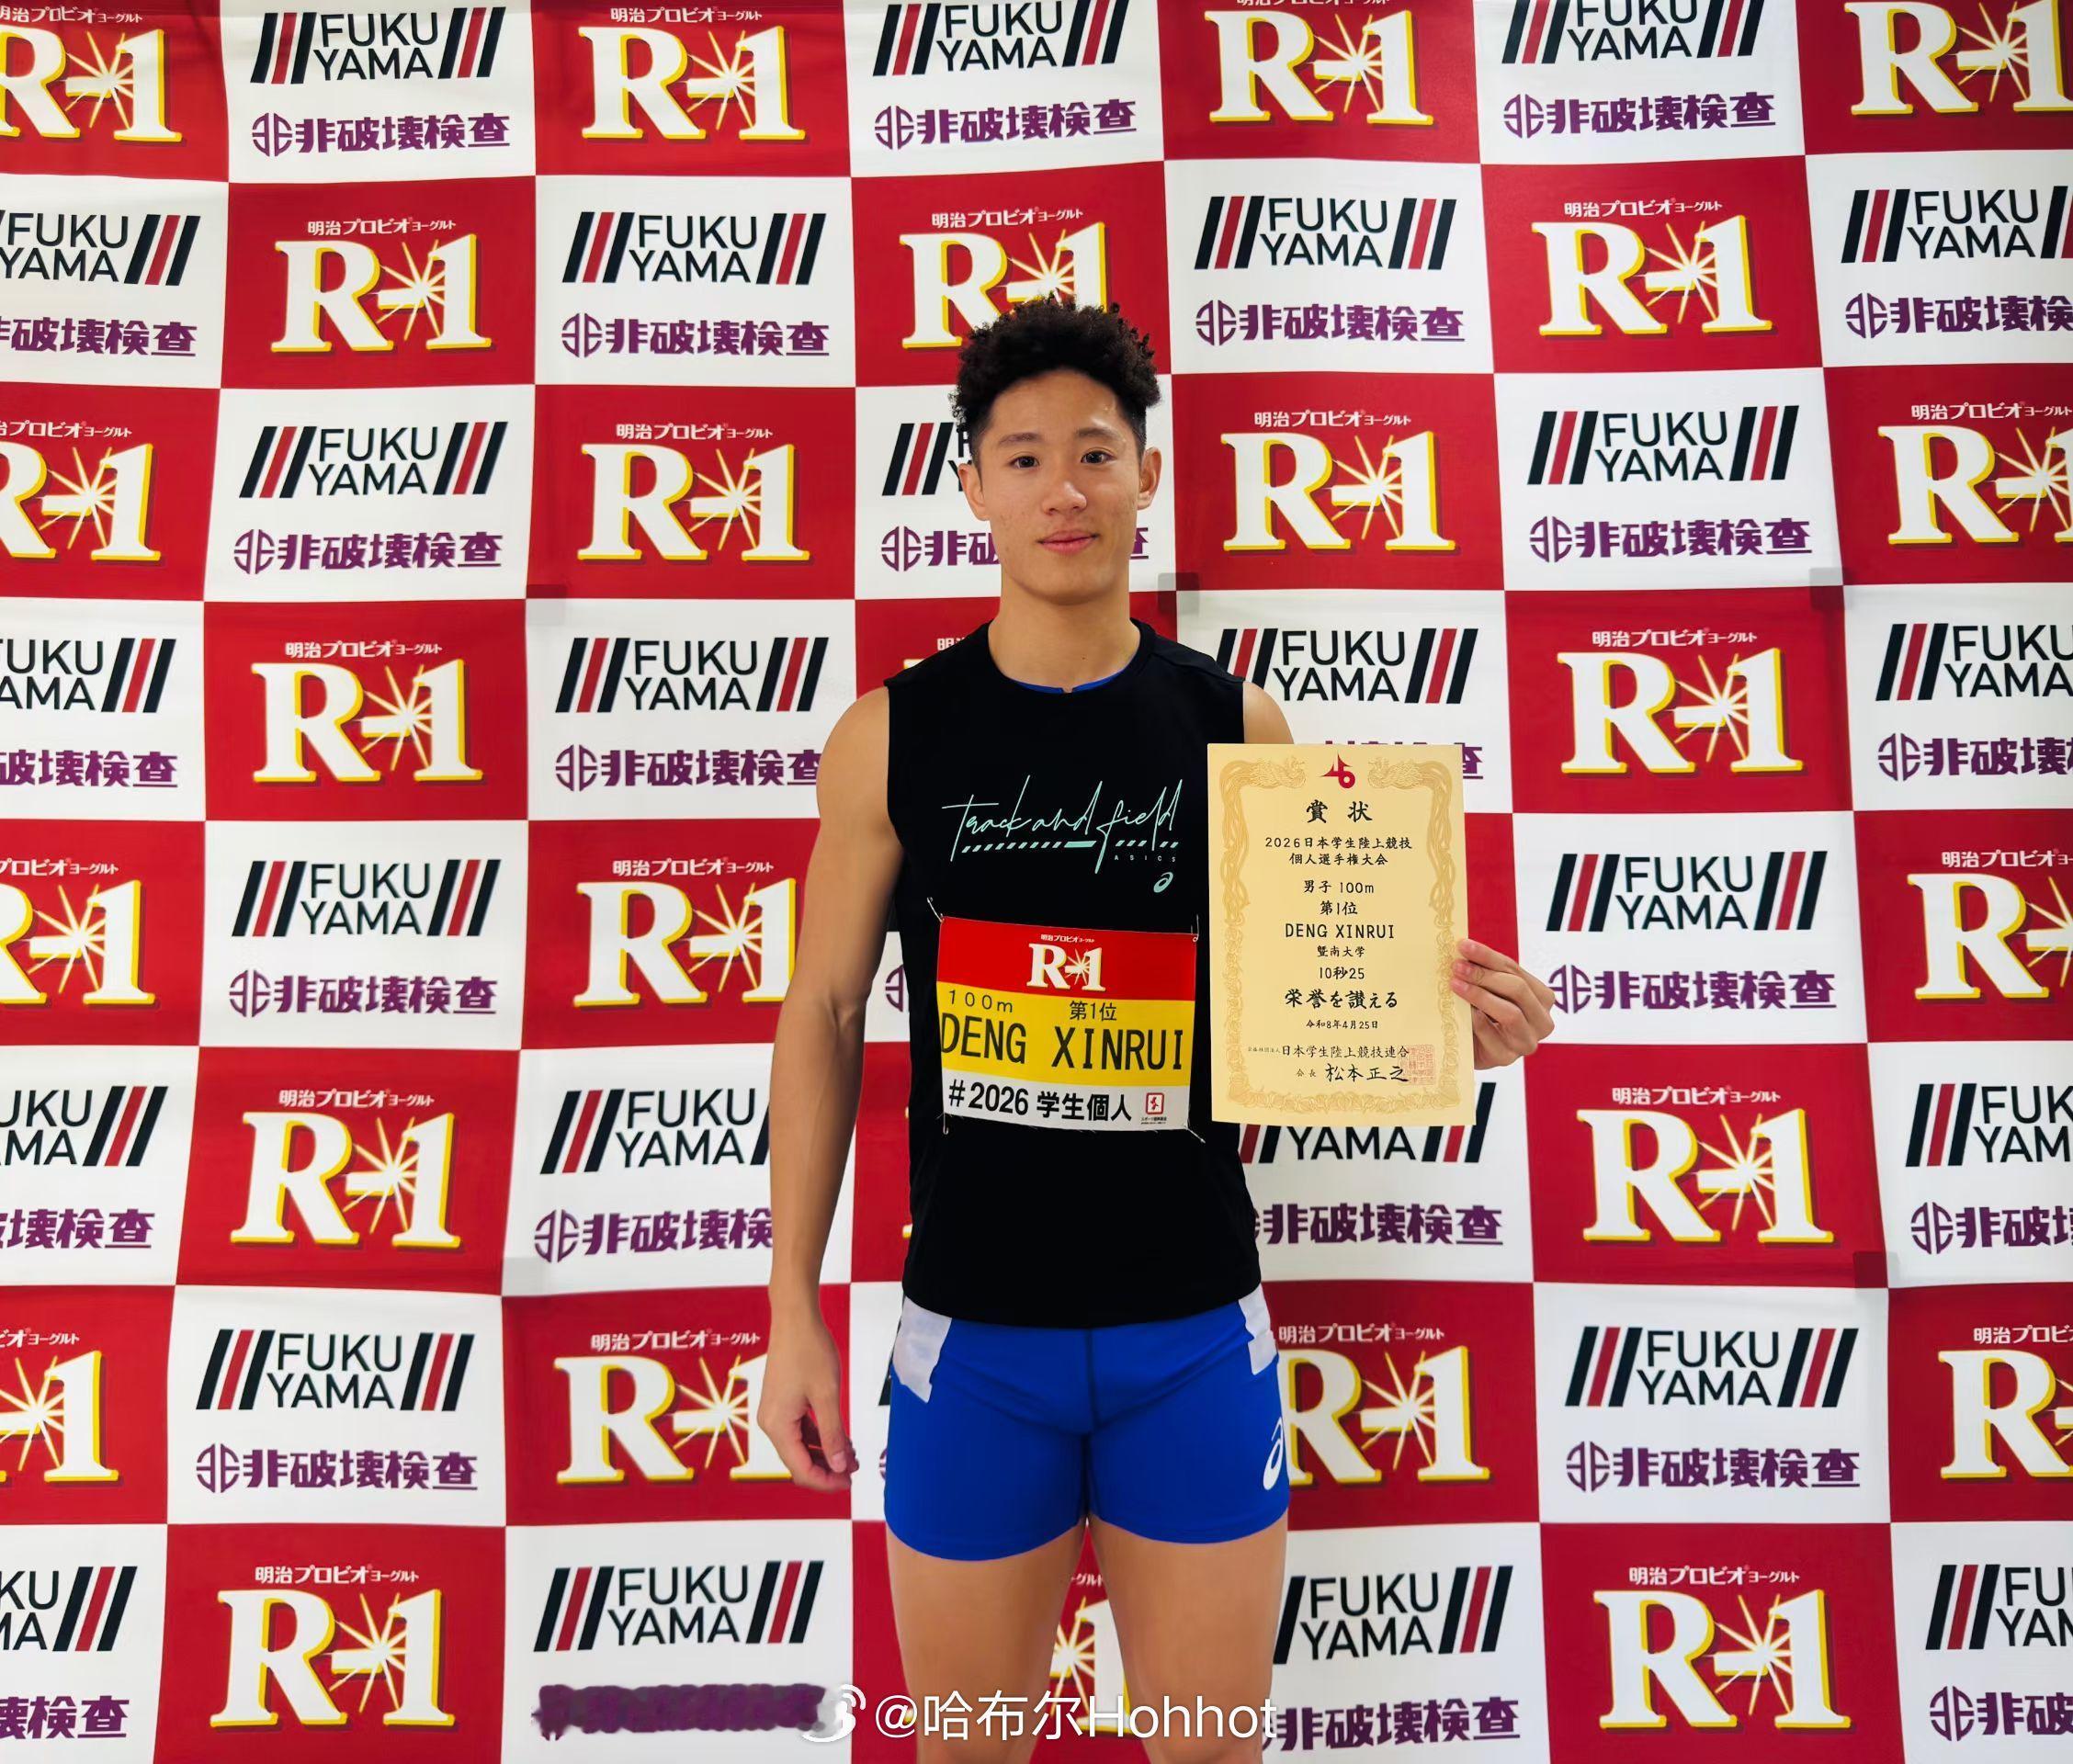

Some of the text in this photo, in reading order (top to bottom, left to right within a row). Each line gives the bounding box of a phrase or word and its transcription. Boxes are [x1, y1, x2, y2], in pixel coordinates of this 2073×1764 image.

[321, 13, 437, 47] FUKU
[611, 7, 762, 22] 明治プロビオヨーグルト
[946, 1, 1061, 38] FUKU
[1578, 0, 1697, 27] FUKU
[936, 37, 1057, 71] YAMA
[1568, 26, 1692, 61] YAMA
[1844, 0, 2073, 115] R-1
[313, 48, 433, 80] YAMA
[1205, 10, 1433, 125] R-1
[0, 24, 182, 141] R-1
[578, 26, 805, 140] R-1
[917, 99, 1136, 143] 非破壊検査
[1547, 92, 1774, 133] 非破壊検査
[296, 114, 508, 153] 非破壊検査
[932, 209, 1082, 228] 明治プロビオヨーグルト
[1269, 198, 1387, 232] FUKU
[1564, 200, 1722, 217] 明治プロビオヨーグルト
[1915, 189, 2038, 224] FUKU
[0, 210, 128, 248] FUKU
[308, 219, 456, 235] 明治プロビオヨーグルト
[640, 215, 756, 249] FUKU
[1908, 225, 2035, 258] YAMA
[0, 247, 119, 281] YAMA
[629, 250, 751, 282] YAMA
[1260, 233, 1382, 266] YAMA
[1532, 215, 1772, 335] R-1
[271, 234, 492, 352] R-1
[0, 317, 196, 356] 破壊検査
[606, 319, 829, 356] 非破壊検査
[1240, 304, 1463, 341] 非破壊検査
[617, 424, 772, 440] 明治プロビオヨーグルト
[1255, 410, 1410, 427] 明治プロビオヨーグルト
[1603, 412, 1727, 447] FUKU
[320, 427, 437, 461] FUKU
[309, 463, 426, 495] YAMA
[1595, 448, 1723, 481] YAMA
[578, 444, 810, 560] R-1
[1221, 431, 1456, 550] R-1
[278, 532, 500, 570] 非破壊検査
[1576, 518, 1811, 557] 非破壊検査
[286, 640, 442, 658] 明治プロビオヨーグルト
[1283, 631, 1405, 666] FUKU
[1592, 629, 1756, 647] 明治プロビオヨーグルト
[0, 639, 102, 674] UKU
[635, 641, 757, 675] FUKU
[625, 678, 750, 710] YAMA
[1273, 668, 1399, 701] YAMA
[1944, 662, 2073, 697] YAMA
[251, 660, 482, 782] R-1
[1558, 648, 1803, 773] R-1
[602, 750, 820, 786] 非破壊検査
[1924, 738, 2073, 775] 非破壊
[942, 775, 1183, 874] Track and field
[1114, 854, 1176, 863] ASICS
[1265, 836, 1412, 850] 2026日本学生陸上競技
[1289, 853, 1388, 865] 個人選手権大会
[312, 864, 429, 899] FUKU
[613, 858, 773, 876] 明治プロビオヨーグルト
[1626, 856, 1752, 892] FUKU
[1304, 879, 1374, 894] 男子 100m
[301, 901, 421, 934] YAMA
[1320, 900, 1358, 915] 第1位
[1616, 895, 1748, 929] YAMA
[573, 878, 796, 1005] R-1
[1286, 923, 1394, 939] DENG XINRUI
[1026, 943, 1106, 991] R-1
[1320, 967, 1365, 980] 10秒25
[275, 976, 496, 1013] 非破壊検査
[947, 989, 1117, 1022] 100m 第1位
[1285, 989, 1398, 1010] 栄誉を讃える
[1595, 970, 1836, 1009] 非破壊検査
[941, 1012, 1184, 1070] DENG XINRUI
[1306, 1019, 1378, 1030] 令和8年4月25日
[1325, 1062, 1410, 1082] 松本正之
[279, 1089, 434, 1107] 明治プロビオヨーグルト
[628, 1089, 754, 1128] FUKU
[1036, 1090, 1132, 1122] 学生個人
[1613, 1086, 1780, 1104] 明治プロビオヨーグルト
[0, 1130, 76, 1165] MA
[617, 1129, 743, 1167] YAMA
[1287, 1126, 1416, 1159] YAMA
[231, 1112, 460, 1248] R-1
[1577, 1109, 1833, 1242] R-1
[0, 1209, 154, 1249] 壊検査
[1263, 1204, 1502, 1245] 非破壊検査
[592, 1330, 760, 1351] 明治プロビオヨーグルト
[1279, 1325, 1444, 1342] 明治プロビオヨーグルト
[1648, 1331, 1778, 1368] FUKU
[278, 1334, 401, 1372] FUKU
[267, 1374, 393, 1408] YAMA
[1637, 1370, 1771, 1405] YAMA
[1278, 1346, 1490, 1486] R-1
[244, 1450, 475, 1490] 非破壊検査
[1614, 1448, 1860, 1487] 非破壊検査
[255, 1565, 418, 1584] 明治プロビオヨーグルト
[619, 1566, 747, 1606] FUKU
[1629, 1566, 1799, 1585] 明治プロビオヨーグルト
[1310, 1573, 1438, 1618] FUKU
[608, 1607, 739, 1645] YAMA
[1300, 1616, 1433, 1660] YAMA
[210, 1589, 455, 1727] R-1
[1593, 1589, 1851, 1728] R-1
